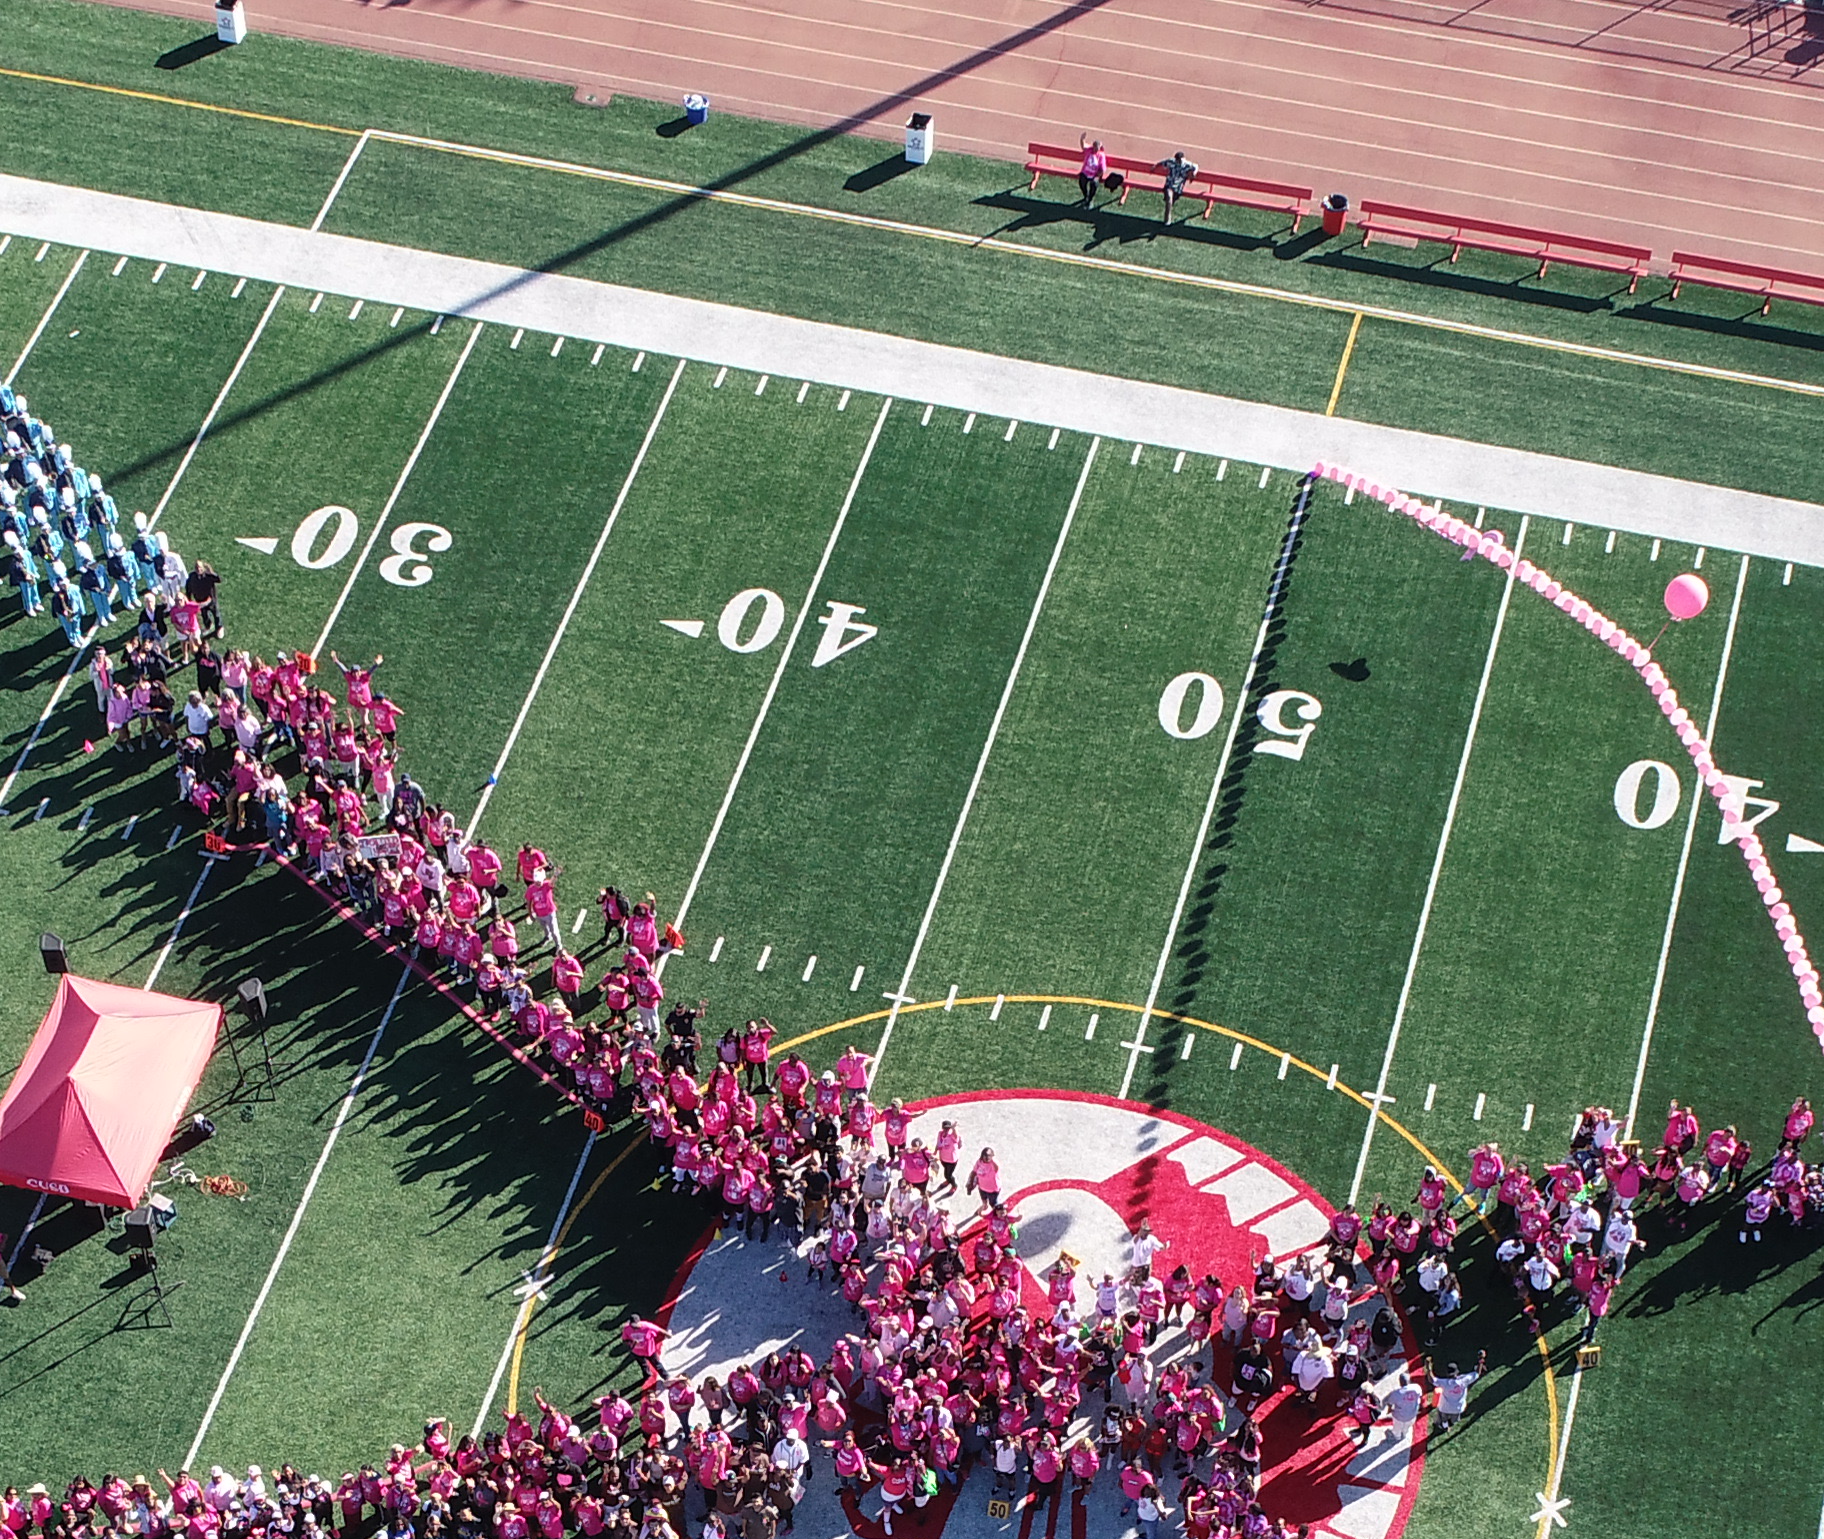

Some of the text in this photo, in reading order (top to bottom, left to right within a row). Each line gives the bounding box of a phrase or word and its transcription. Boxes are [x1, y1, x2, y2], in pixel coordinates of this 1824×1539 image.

[291, 506, 452, 587] 30
[718, 589, 878, 667] 40
[1158, 672, 1321, 761] 50
[26, 1178, 70, 1195] CUSD
[990, 1502, 1007, 1518] 50
